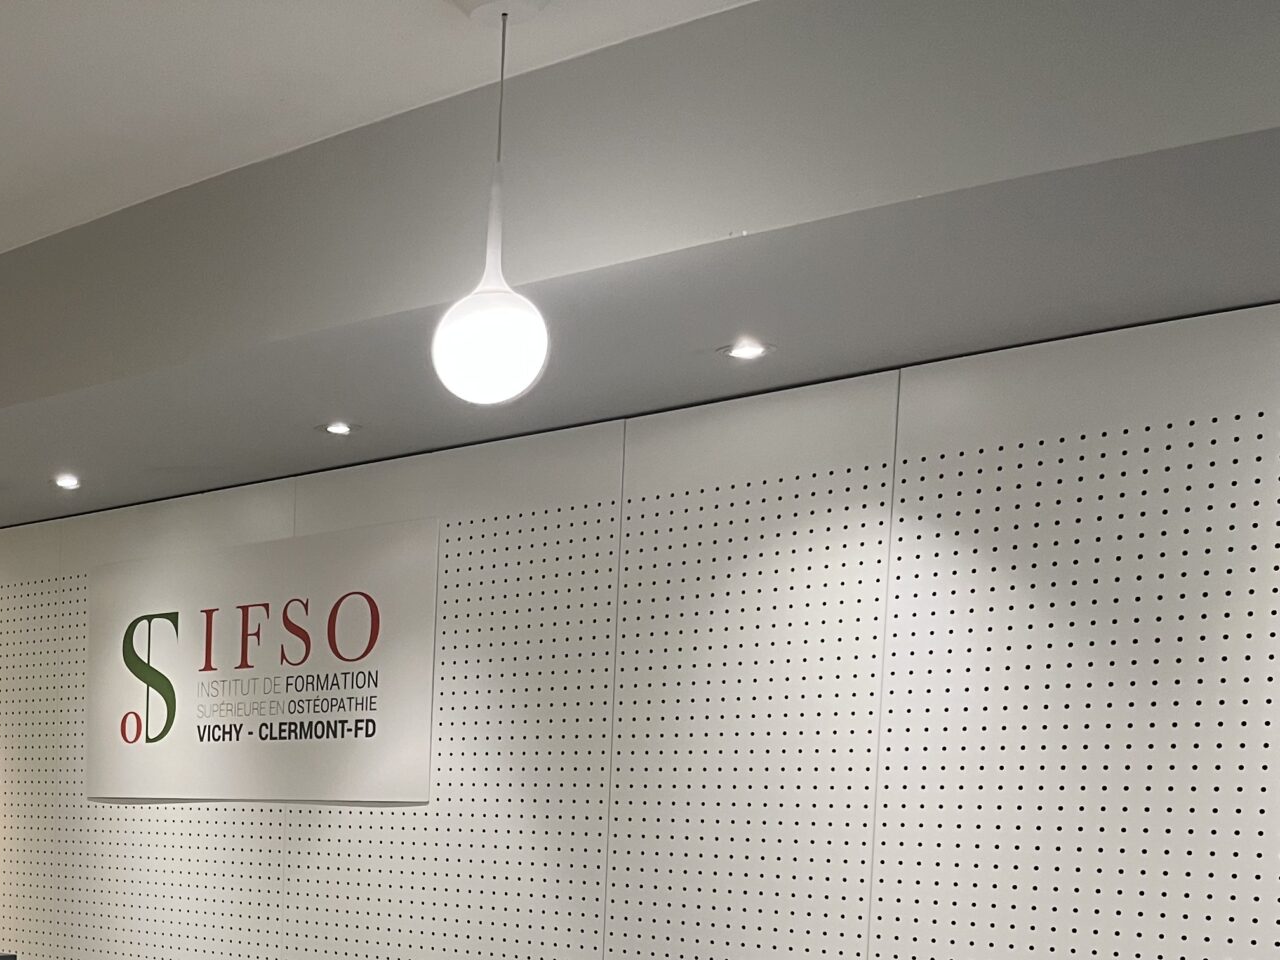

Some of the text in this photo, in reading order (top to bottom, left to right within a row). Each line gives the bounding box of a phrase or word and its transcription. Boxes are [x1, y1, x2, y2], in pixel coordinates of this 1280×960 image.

[198, 591, 380, 672] IFSO
[196, 670, 379, 698] INSTITUT DE FORMATION
[196, 695, 378, 719] SUPÉRIEURE EN OSTÉOPATHIE
[197, 723, 244, 742] VICHY
[258, 719, 377, 741] CLERMONT-FD
